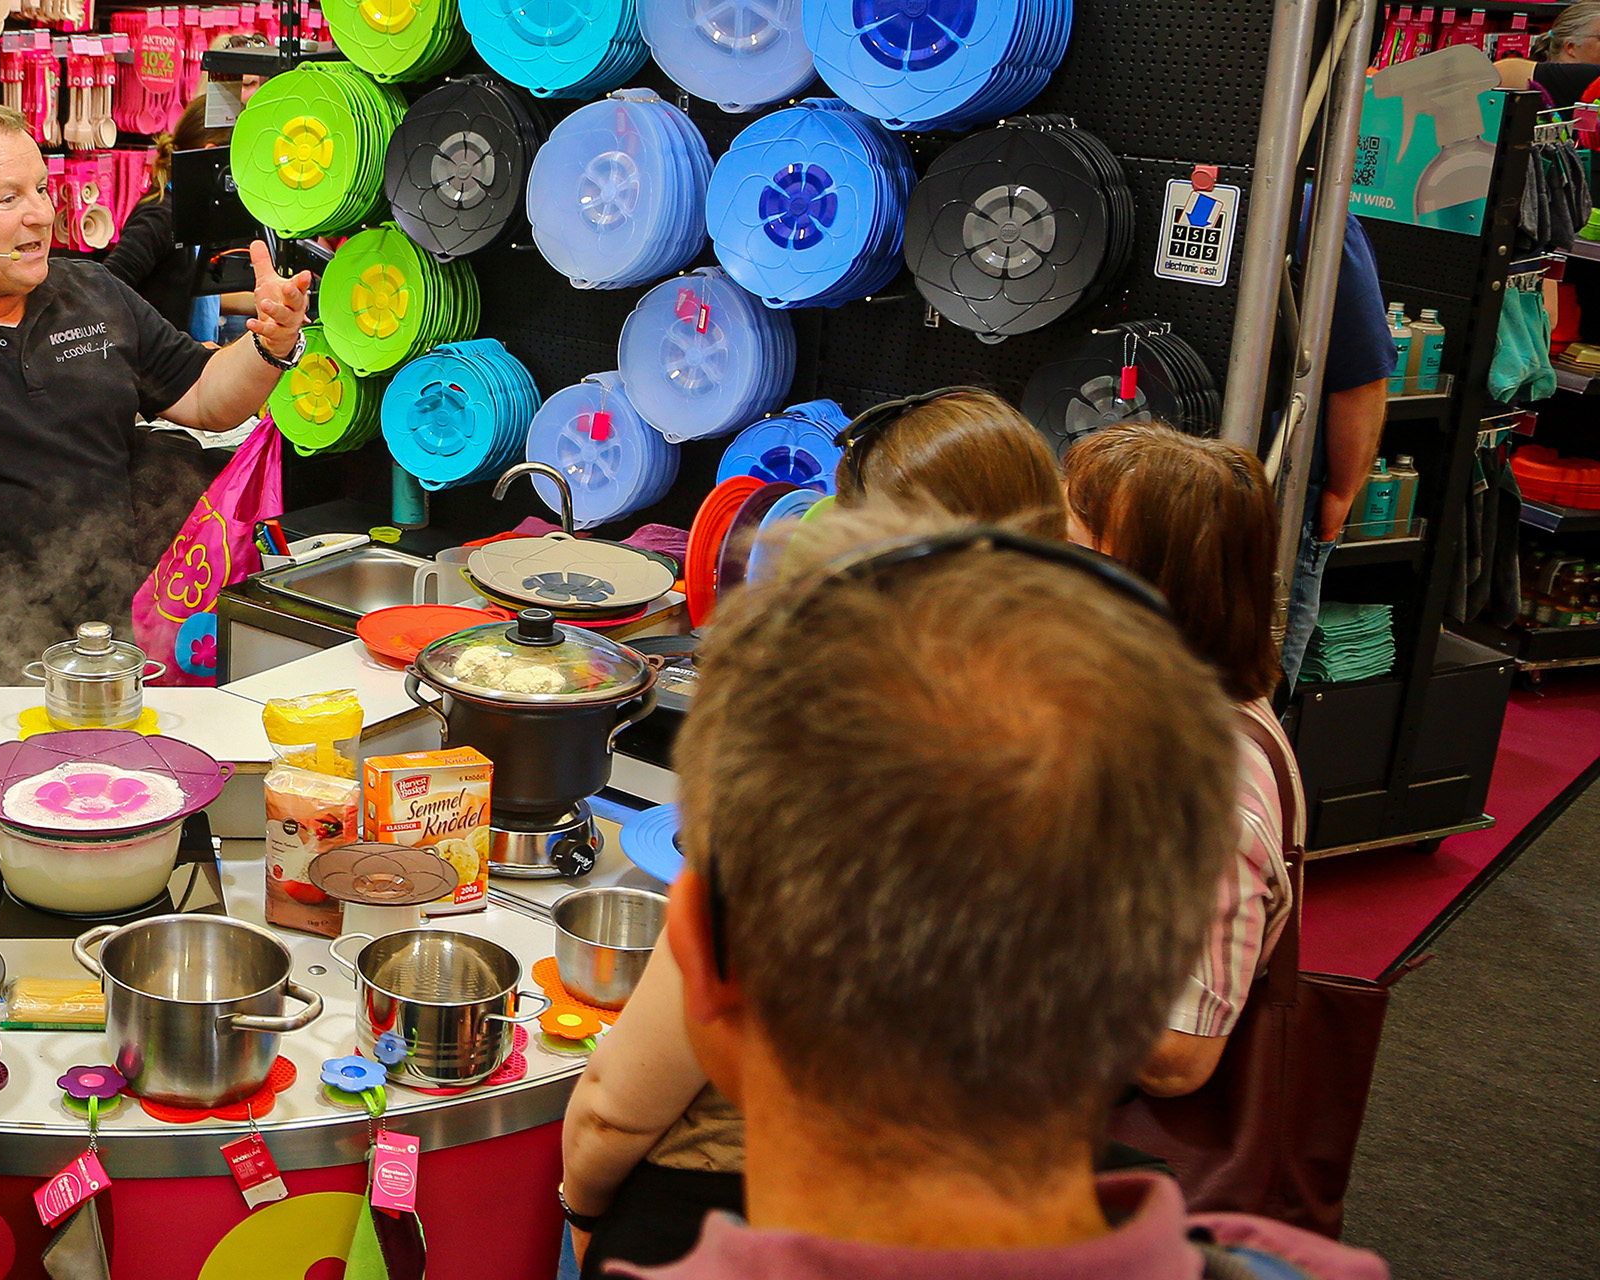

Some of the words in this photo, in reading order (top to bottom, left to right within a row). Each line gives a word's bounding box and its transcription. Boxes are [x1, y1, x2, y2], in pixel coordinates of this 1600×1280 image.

[142, 34, 175, 46] AKTION
[142, 51, 174, 68] 10%
[1364, 194, 1396, 209] WIRD.
[1175, 227, 1184, 237] 4
[1191, 229, 1200, 240] 5
[1207, 231, 1216, 242] 6
[1174, 243, 1181, 254] 7
[1189, 245, 1198, 256] 8
[1204, 247, 1214, 258] 9
[1165, 260, 1199, 273] electronic
[1200, 265, 1217, 276] cash
[49, 322, 107, 346] KOCHBLUME
[56, 354, 65, 363] by
[400, 777, 428, 790] Harvest
[464, 773, 486, 781] Knödel
[401, 785, 427, 798] Basket
[407, 788, 467, 820] Semmel
[386, 822, 417, 831] KLASSISCH
[422, 802, 487, 839] Knödel
[461, 885, 478, 895] 200g
